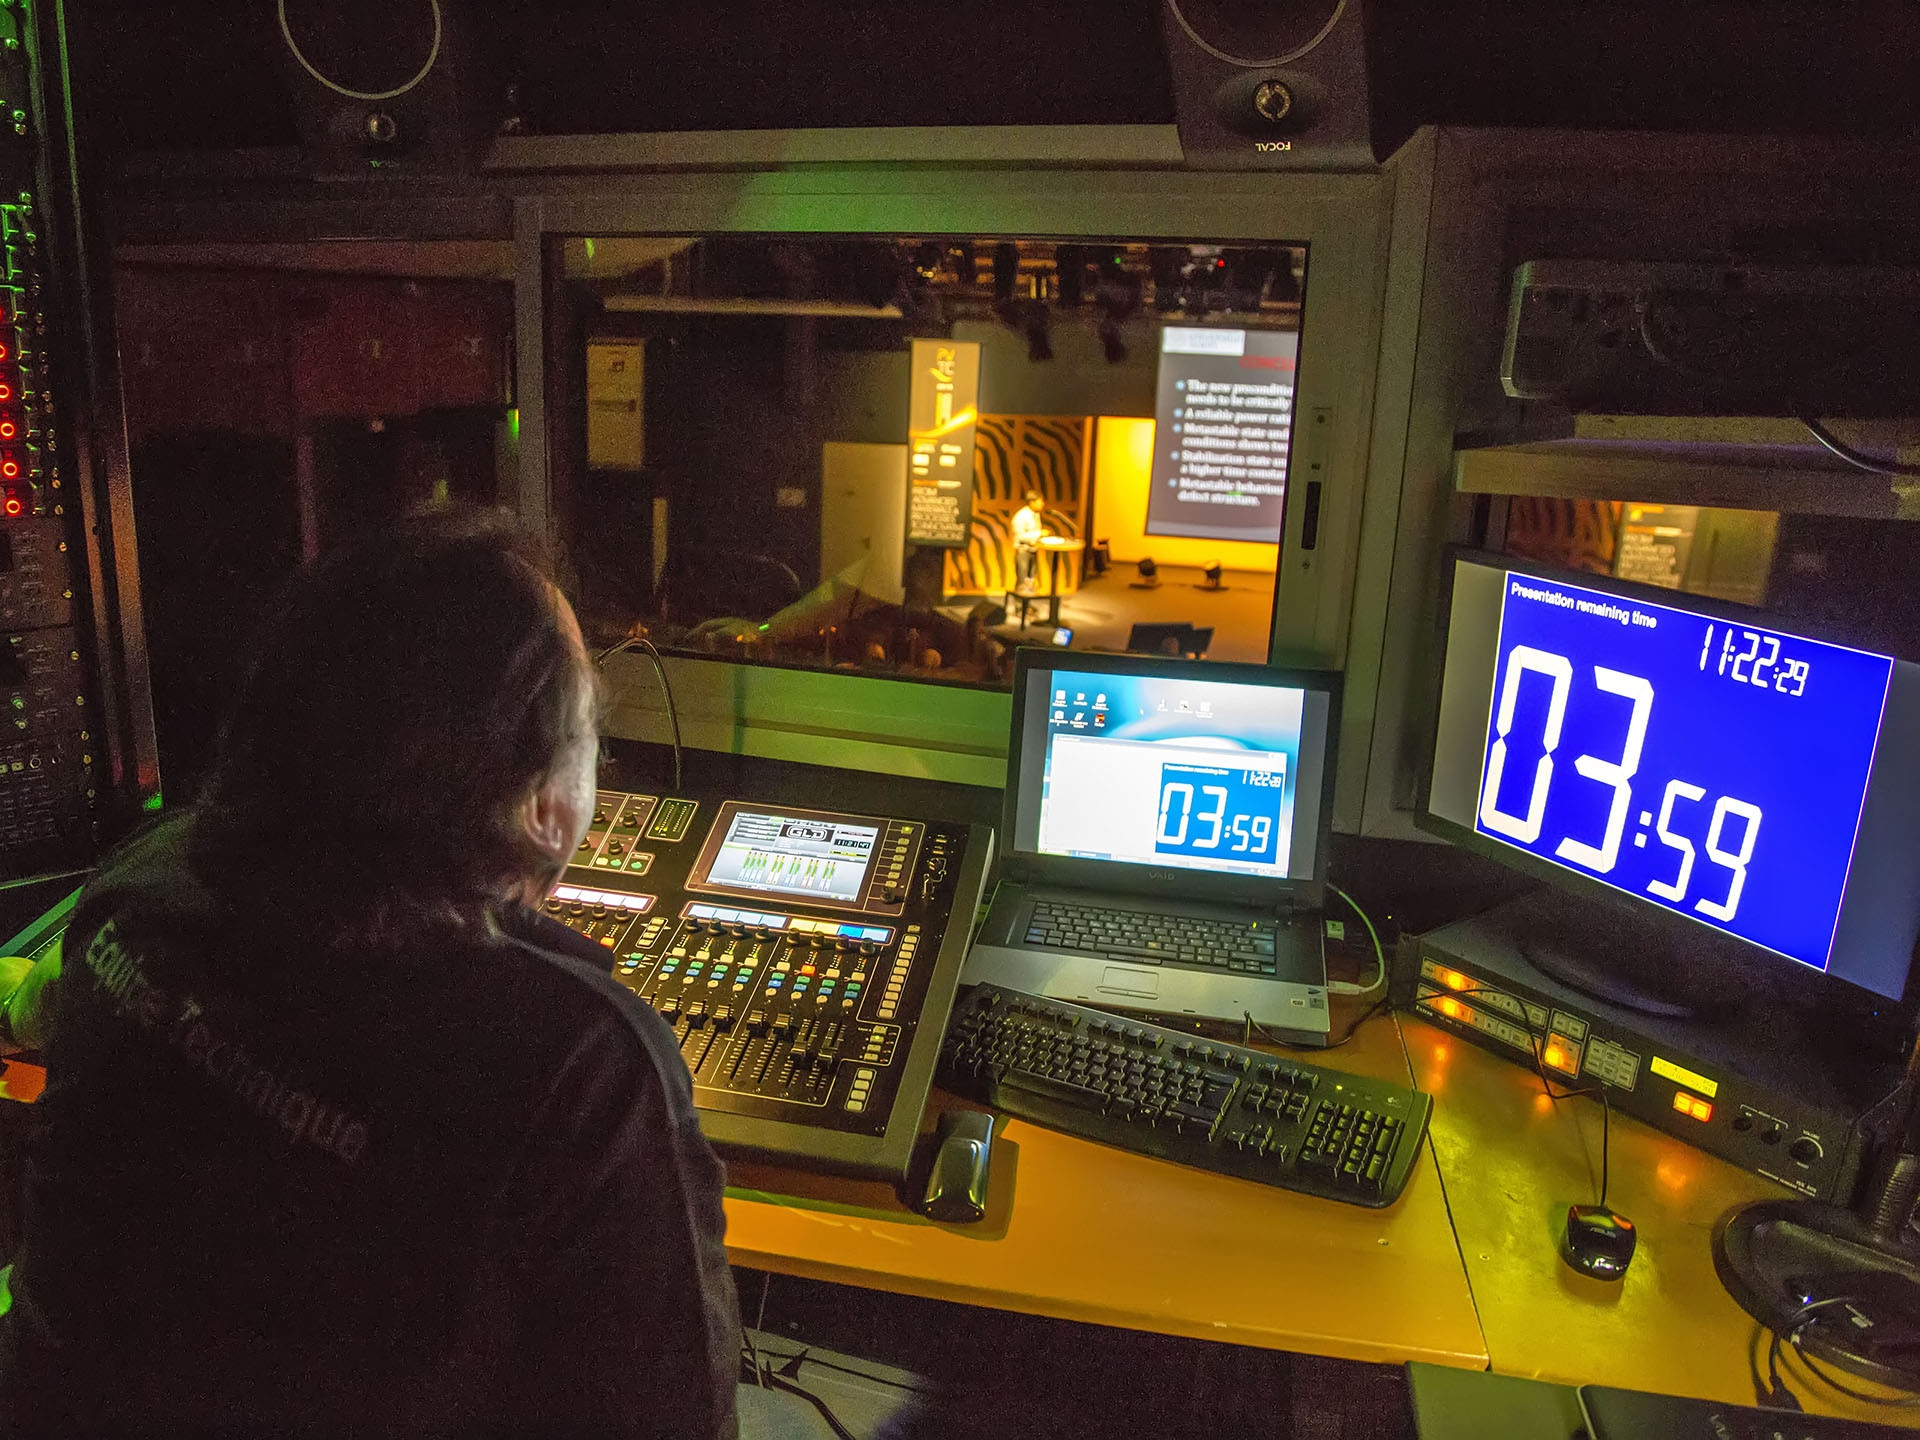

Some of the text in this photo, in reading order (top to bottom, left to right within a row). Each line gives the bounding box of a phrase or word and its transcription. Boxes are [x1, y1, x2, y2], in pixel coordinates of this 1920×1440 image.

[1255, 141, 1291, 151] FOCAL
[1187, 379, 1208, 392] The
[1208, 383, 1232, 393] new
[1185, 393, 1289, 411] needs to be critically
[1185, 408, 1194, 419] A
[1195, 408, 1234, 420] reliable
[1234, 412, 1268, 424] power
[1184, 423, 1240, 436] Metastable
[1241, 427, 1266, 438] state
[1182, 437, 1236, 448] conditions
[1237, 439, 1270, 451] shows
[1246, 455, 1271, 466] state
[1180, 464, 1188, 474] a
[1188, 463, 1222, 477] higher
[1222, 466, 1247, 477] time
[1180, 478, 1235, 491] Metastable
[1177, 490, 1210, 502] defect
[1511, 582, 1657, 628] Presentation remaining time
[1700, 623, 1810, 697] 11:22:29
[1480, 644, 1763, 922] 03:59
[1157, 782, 1271, 854] 03:59
[788, 827, 826, 839] GLD
[1149, 872, 1175, 881] VAIO
